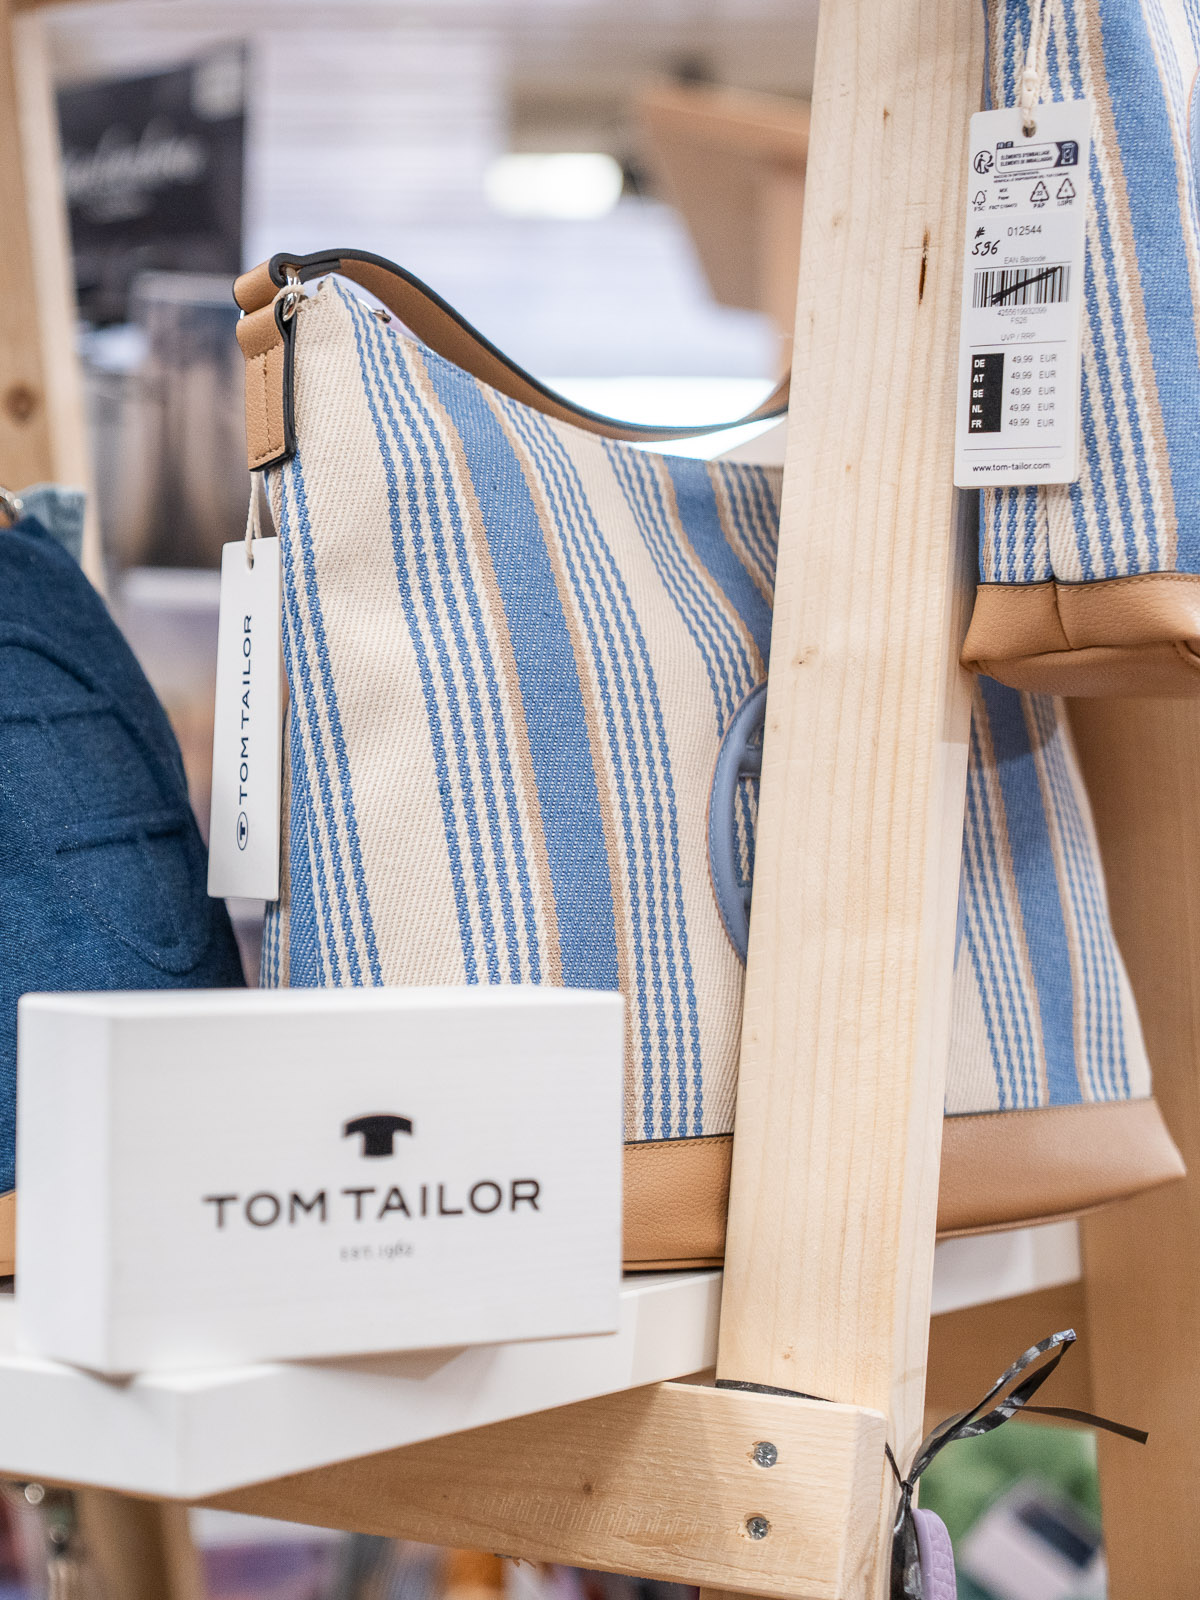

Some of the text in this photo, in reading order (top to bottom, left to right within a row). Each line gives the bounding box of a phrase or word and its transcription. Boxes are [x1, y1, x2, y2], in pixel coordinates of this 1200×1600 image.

[1007, 225, 1042, 237] 012544
[971, 239, 1001, 257] 596
[1020, 255, 1046, 263] Barcode
[974, 358, 986, 368] DE
[1040, 353, 1057, 363] EUR
[973, 373, 985, 383] AT
[1039, 370, 1056, 379] EUR
[972, 388, 984, 398] BE
[1038, 386, 1056, 395] EUR
[971, 404, 983, 413] NL
[1037, 402, 1055, 412] EUR
[971, 419, 982, 429] FR
[1037, 418, 1054, 428] EUR
[972, 462, 1051, 472] www.tom-tailor.com
[238, 614, 253, 805] TOM TAILOR
[202, 1178, 542, 1231] TOM TAILOR
